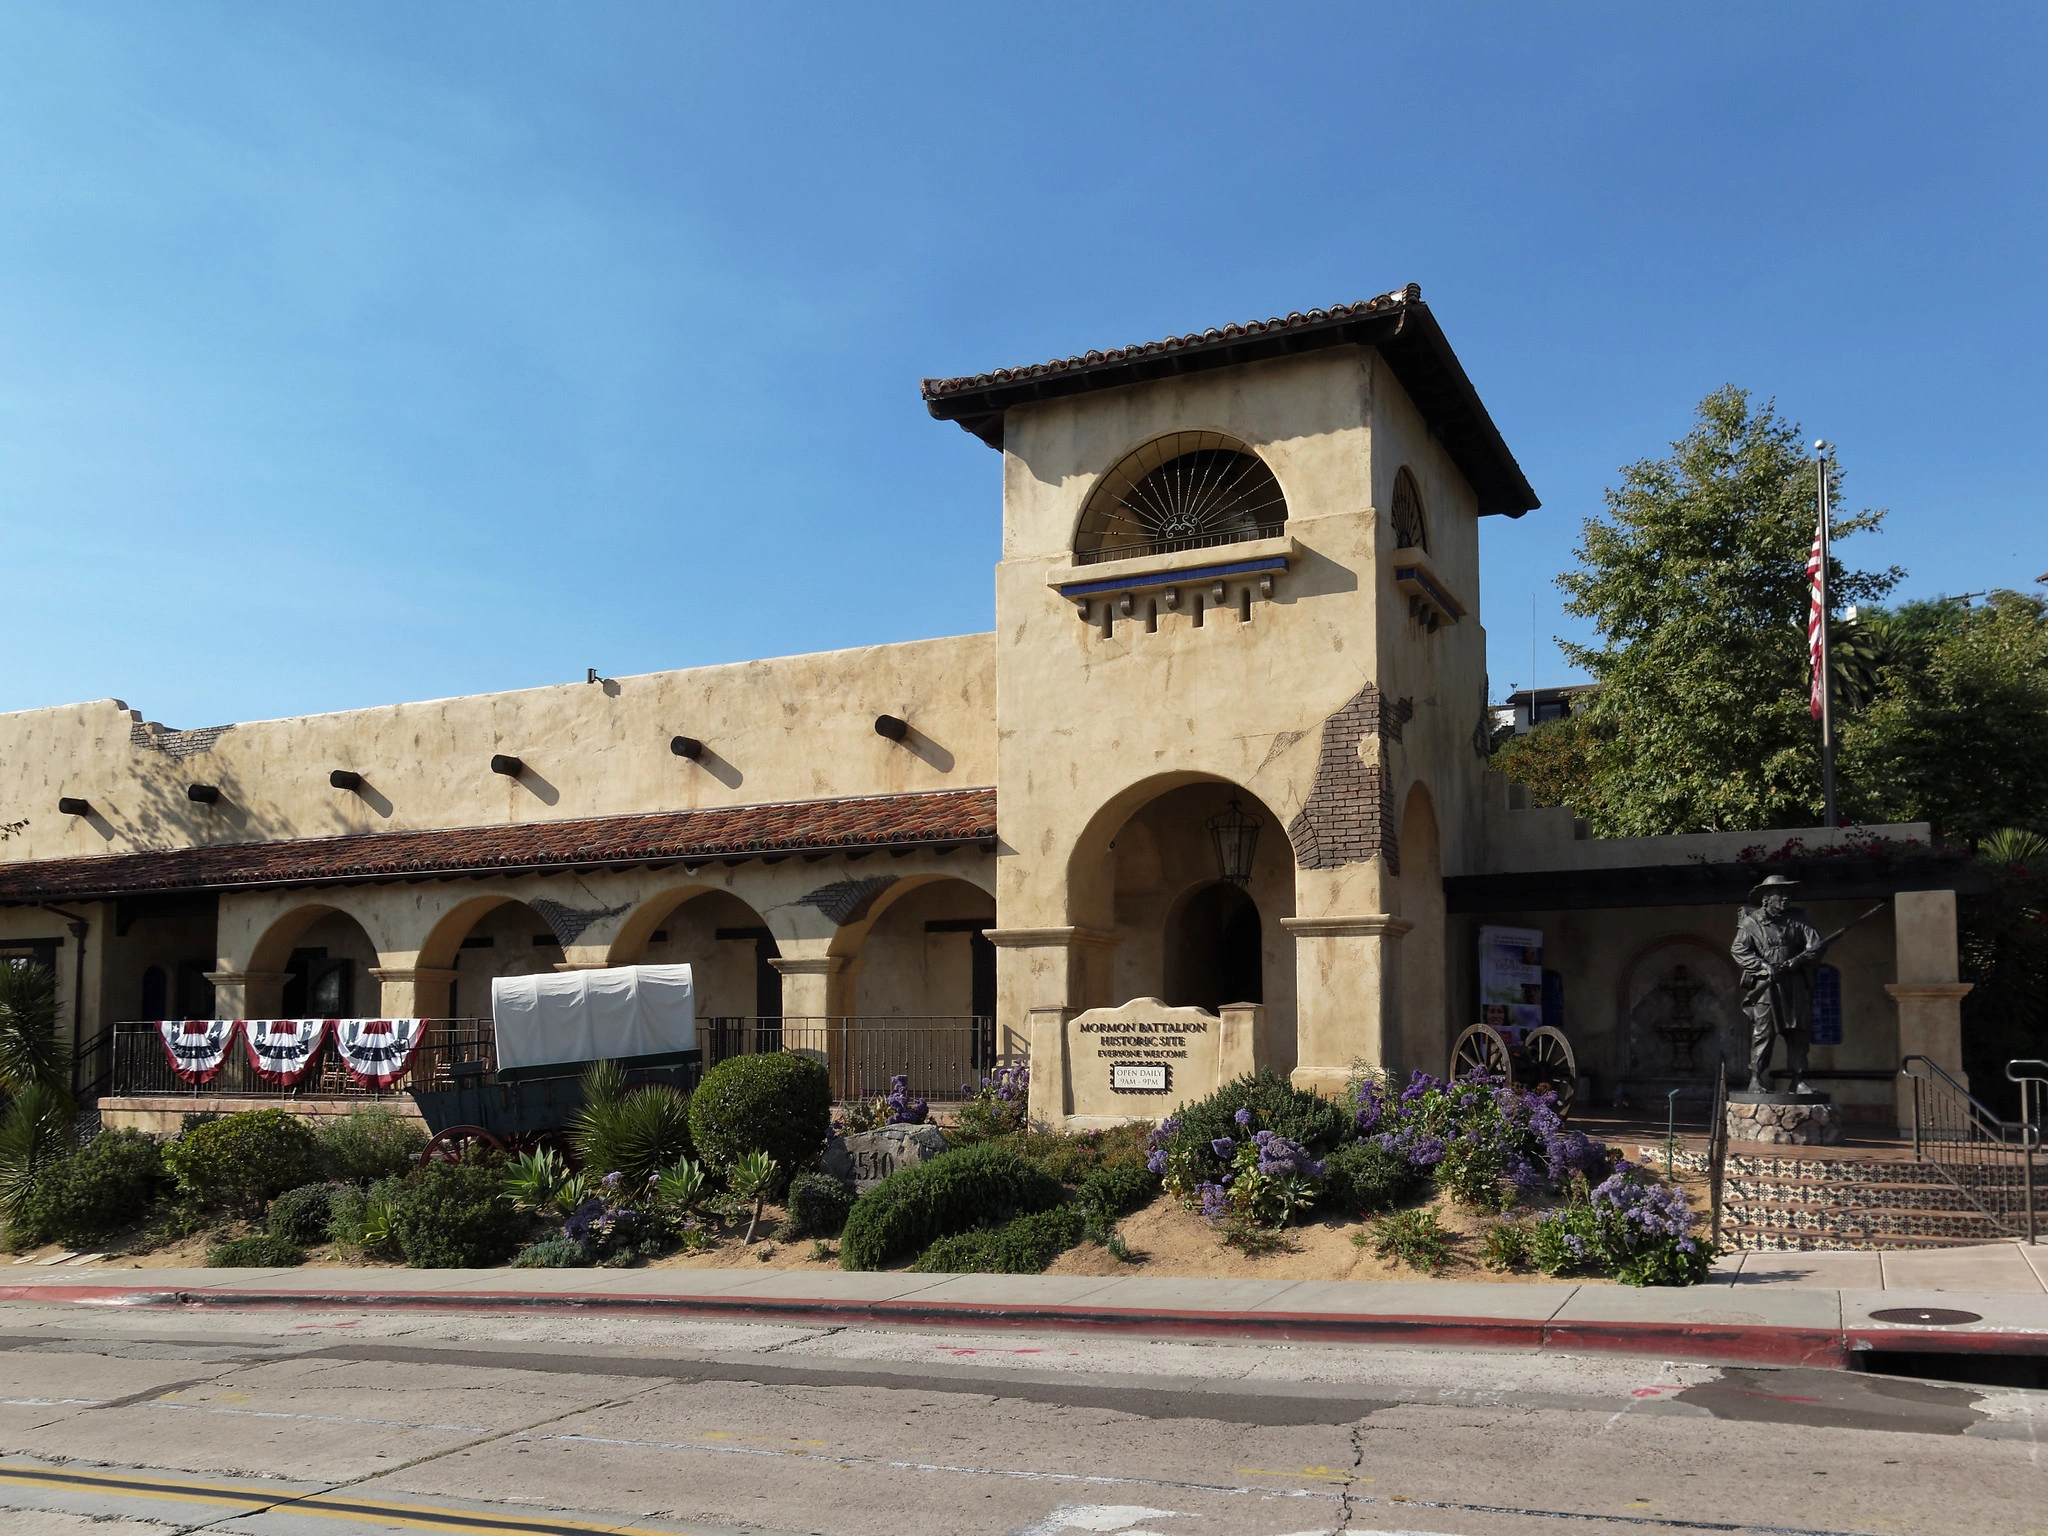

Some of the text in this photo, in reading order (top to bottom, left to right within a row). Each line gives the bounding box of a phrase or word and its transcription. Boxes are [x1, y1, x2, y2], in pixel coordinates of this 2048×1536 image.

[1080, 1022, 1208, 1033] MORMON BATTALION
[1100, 1036, 1186, 1047] HISTORIC SITE
[1097, 1049, 1188, 1059] EVERYONE WELCOME
[1116, 1069, 1163, 1077] OPEN DAILY
[1120, 1078, 1136, 1086] 9AM
[1142, 1078, 1159, 1086] 9PM
